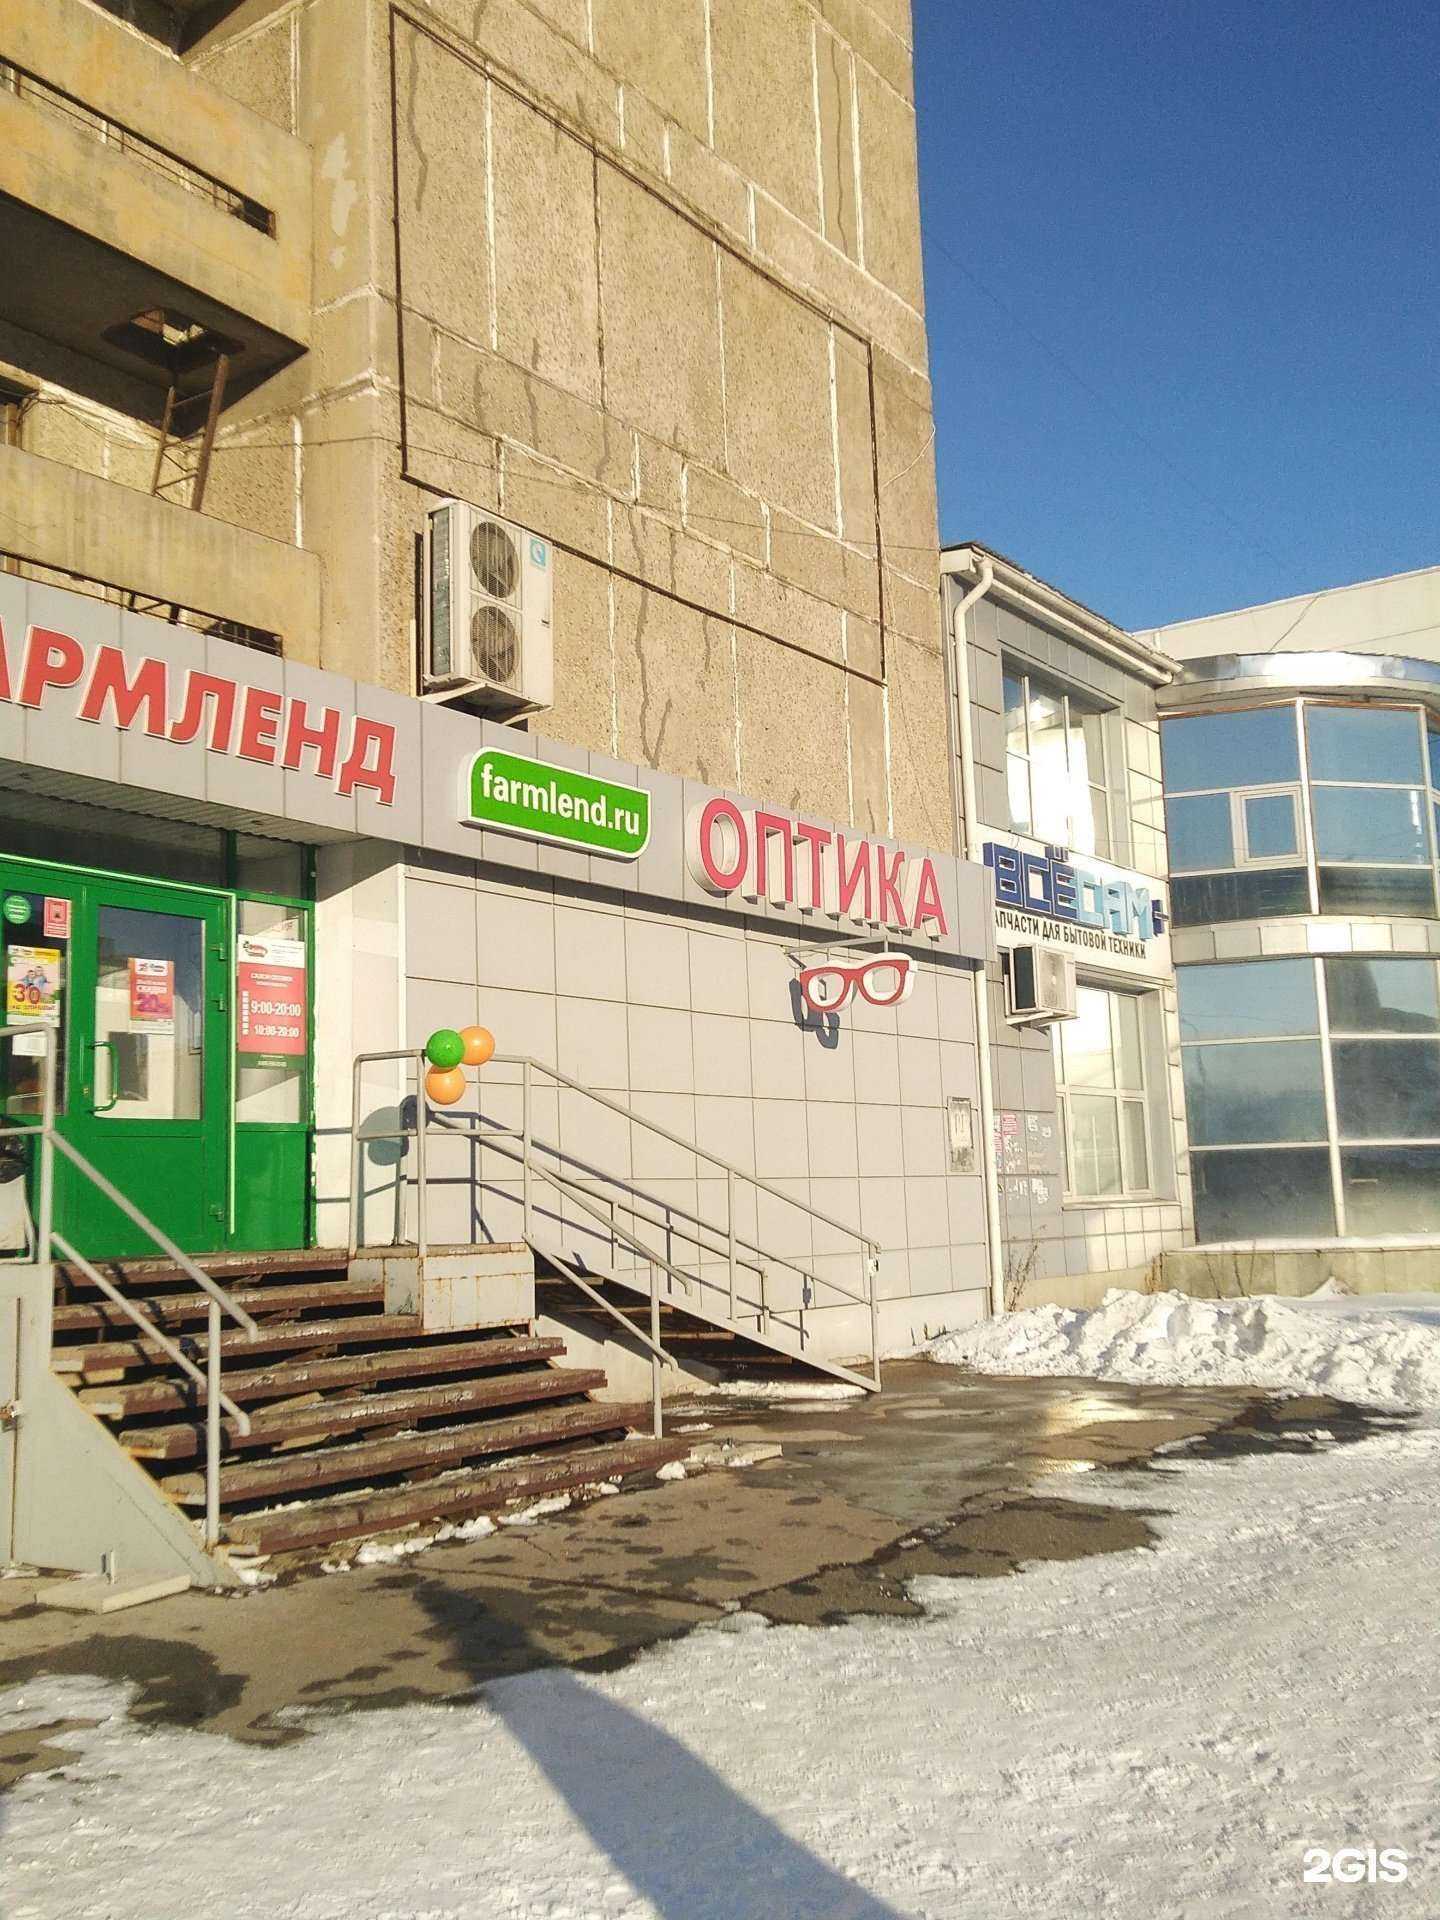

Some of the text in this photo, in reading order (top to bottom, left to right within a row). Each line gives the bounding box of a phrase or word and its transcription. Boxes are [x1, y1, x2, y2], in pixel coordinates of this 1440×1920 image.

[480, 761, 640, 836] farmlend.ru
[690, 796, 949, 940] ОПТИКА
[1042, 921, 1061, 941] ДЛЯ
[1063, 926, 1106, 952] БЫТОВОЙ
[1108, 935, 1147, 959] ТЕХНИКИ
